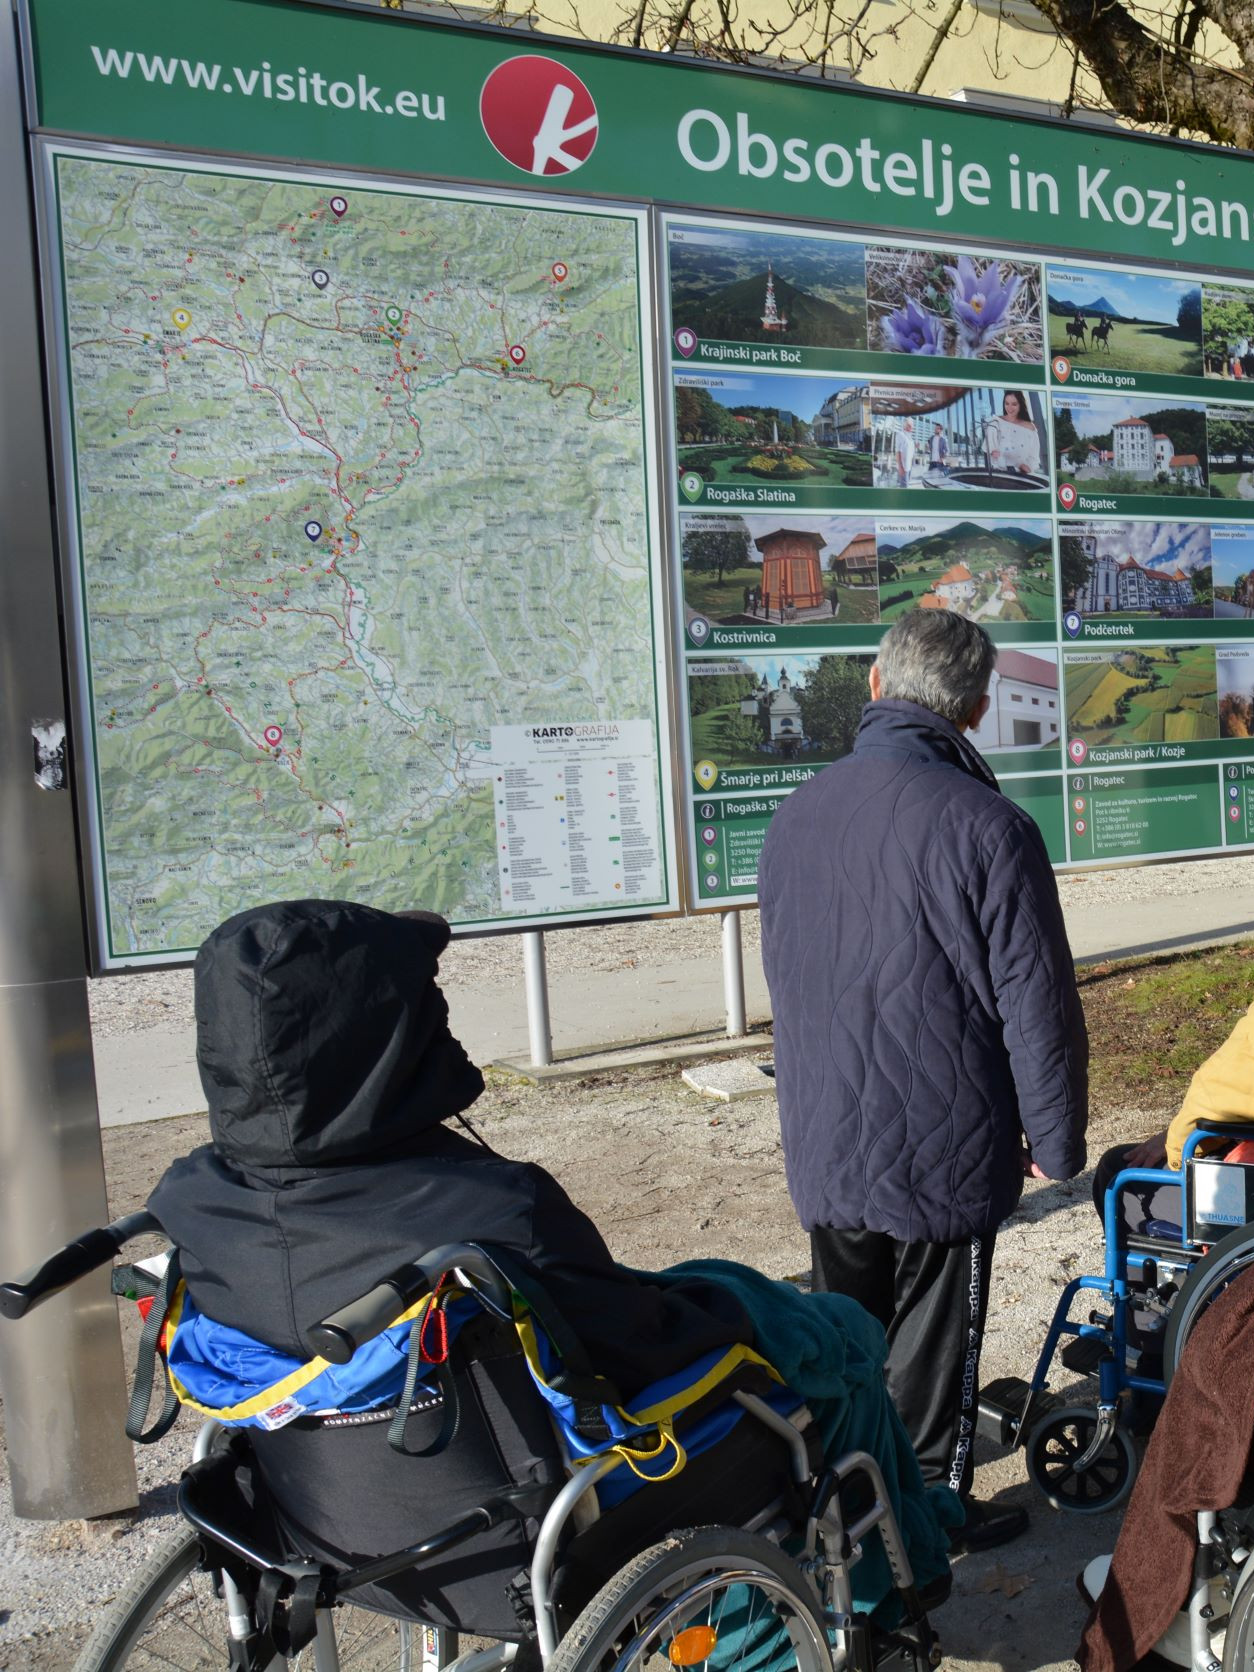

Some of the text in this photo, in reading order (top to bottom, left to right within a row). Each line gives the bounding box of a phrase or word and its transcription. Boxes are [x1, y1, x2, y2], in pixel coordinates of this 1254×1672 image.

[90, 45, 446, 121] www.visitok.eu
[677, 109, 991, 216] Obsotelje
[1009, 155, 1059, 213] in
[700, 343, 801, 363] Krajinski park Boč
[710, 380, 724, 388] park
[1073, 370, 1136, 388] Donačka gora
[707, 487, 796, 503] Rogaška Slatina
[1079, 497, 1117, 513] Rogatec
[713, 630, 776, 645] Kostrivnica
[1084, 622, 1135, 637] Podčetrtek
[1089, 749, 1133, 763] Kozjanski
[1134, 748, 1155, 762] park
[1162, 745, 1186, 759] Kozje
[720, 769, 761, 787] Šmarje
[763, 771, 779, 787] pri
[1093, 776, 1125, 788] Rogatec
[726, 801, 767, 815] Rogaška
[1207, 1212, 1245, 1224] THUASNE
[970, 1257, 982, 1321] Kappa
[962, 1349, 976, 1410] Kappa
[949, 1436, 969, 1492] Kappa
